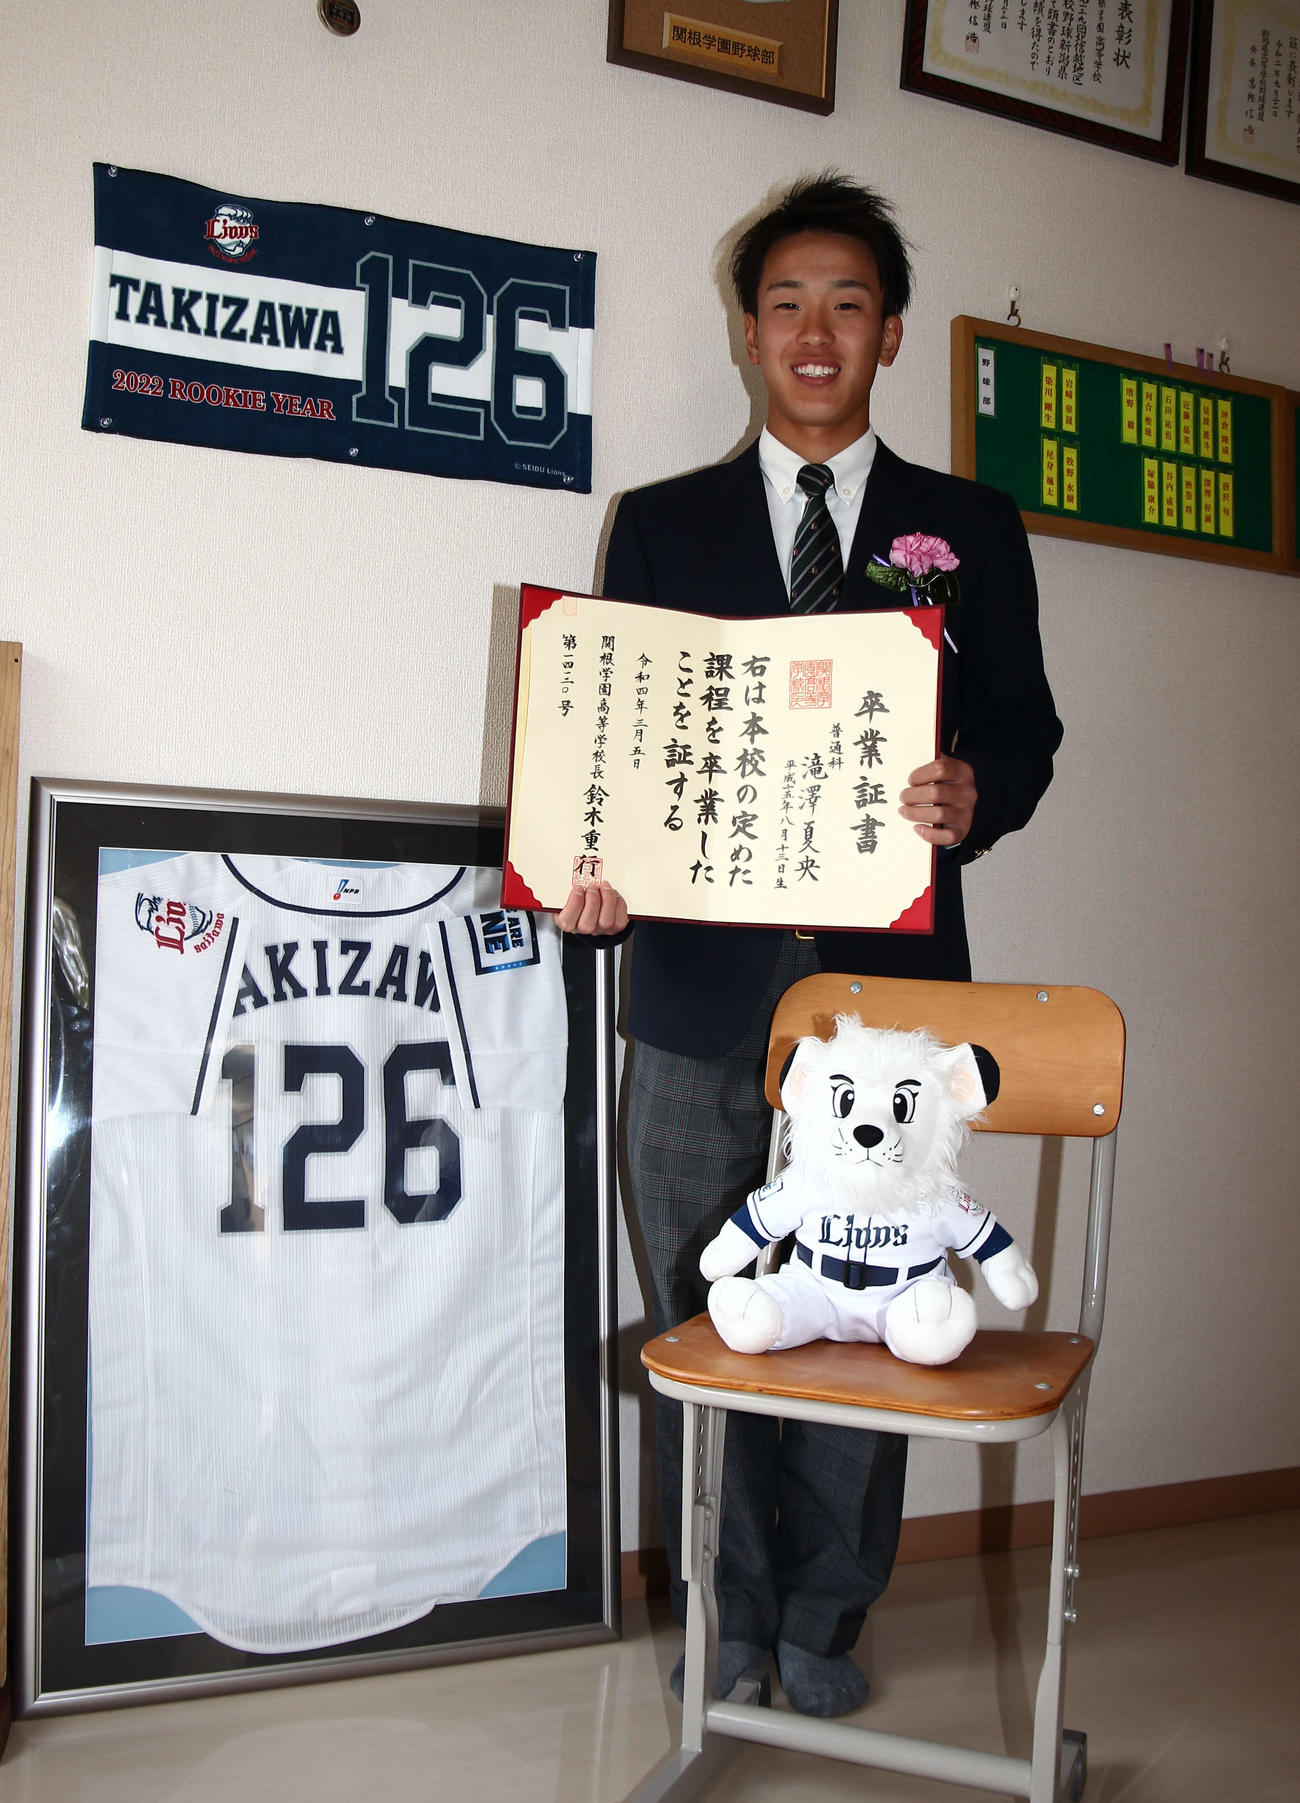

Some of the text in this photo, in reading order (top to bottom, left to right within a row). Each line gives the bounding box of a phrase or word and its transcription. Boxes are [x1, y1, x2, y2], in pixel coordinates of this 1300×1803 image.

[672, 25, 775, 66] 関根学園野球部
[204, 218, 260, 240] Lions
[109, 272, 345, 355] TAKIZAWA
[352, 251, 570, 450] 126
[112, 368, 336, 420] 2022 ROOKIE YEAR
[522, 463, 545, 473] SEIBU
[629, 652, 653, 770] 令和四年三月五日
[662, 651, 695, 831] ことを証する
[689, 652, 736, 885] 課程を卒業した
[728, 655, 771, 888] 右は本校の定めた
[828, 723, 844, 771] 普通科
[850, 690, 890, 854] 卒業証書
[774, 759, 797, 889] 平成十五年八月十三日生
[794, 753, 829, 882] 滝澤夏央
[218, 1038, 463, 1234] 126
[818, 1213, 910, 1249] Lions
